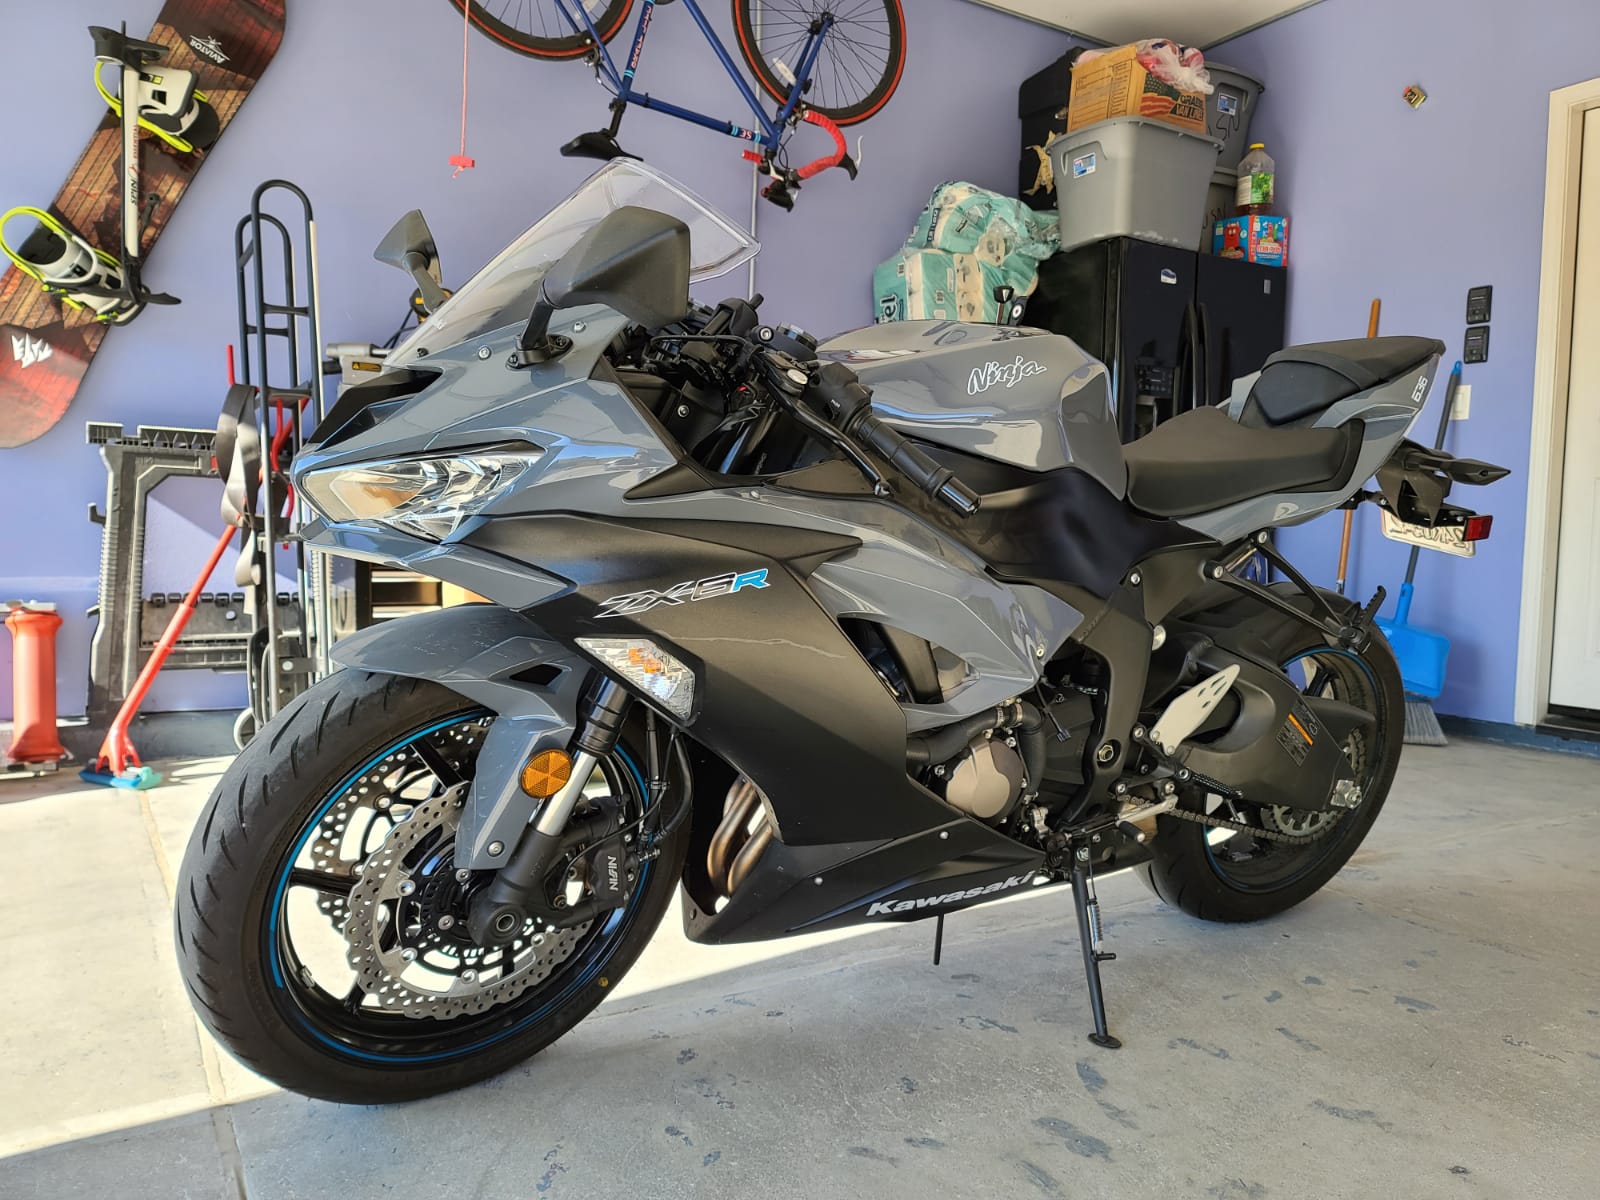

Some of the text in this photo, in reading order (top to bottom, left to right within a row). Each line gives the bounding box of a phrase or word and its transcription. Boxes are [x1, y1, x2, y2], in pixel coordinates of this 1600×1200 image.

[190, 39, 226, 63] AVIATOR
[967, 355, 1048, 396] Ninja
[1411, 375, 1428, 402] 636
[865, 870, 1036, 917] Kawasaki
